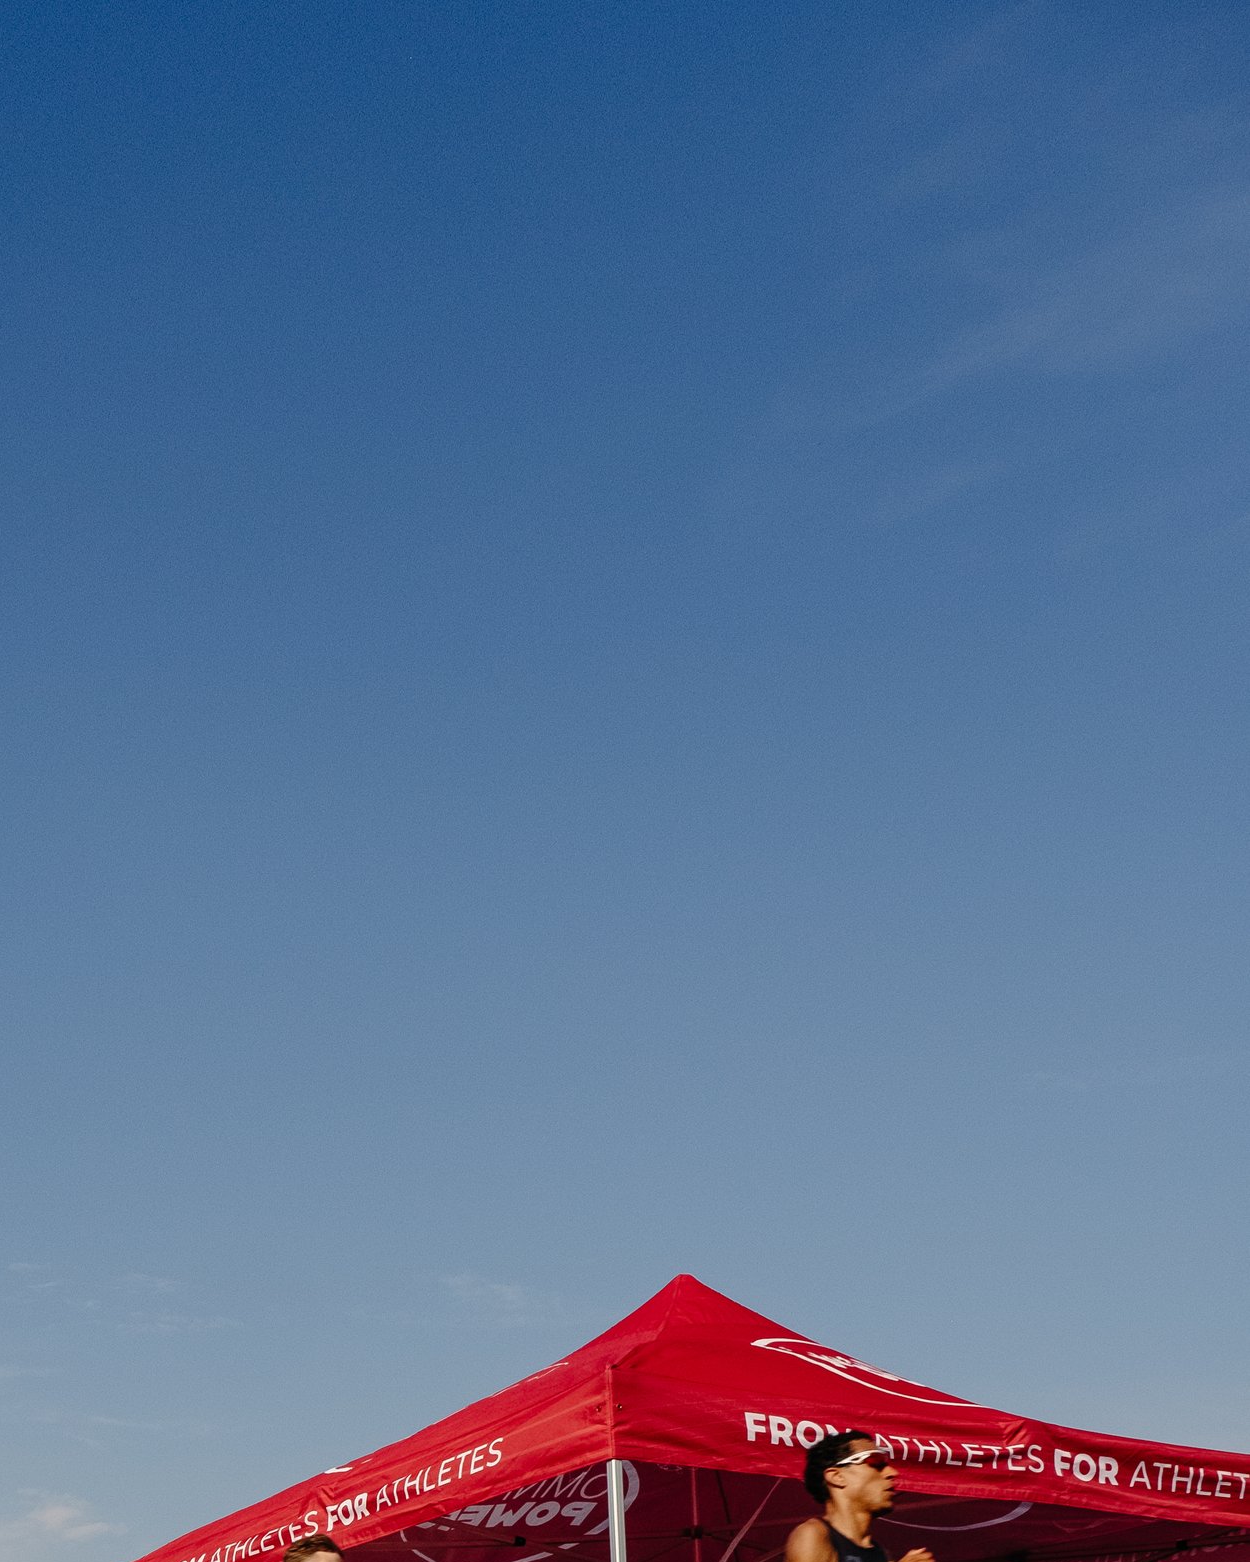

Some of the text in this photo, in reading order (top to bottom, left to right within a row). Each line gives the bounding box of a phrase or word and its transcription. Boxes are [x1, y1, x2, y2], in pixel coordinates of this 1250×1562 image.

[326, 1492, 370, 1532] FOR
[376, 1437, 504, 1512] ATHLETES
[744, 1411, 852, 1450] FRO
[875, 1433, 1045, 1473] ATHLETES
[1053, 1448, 1119, 1486] FOR
